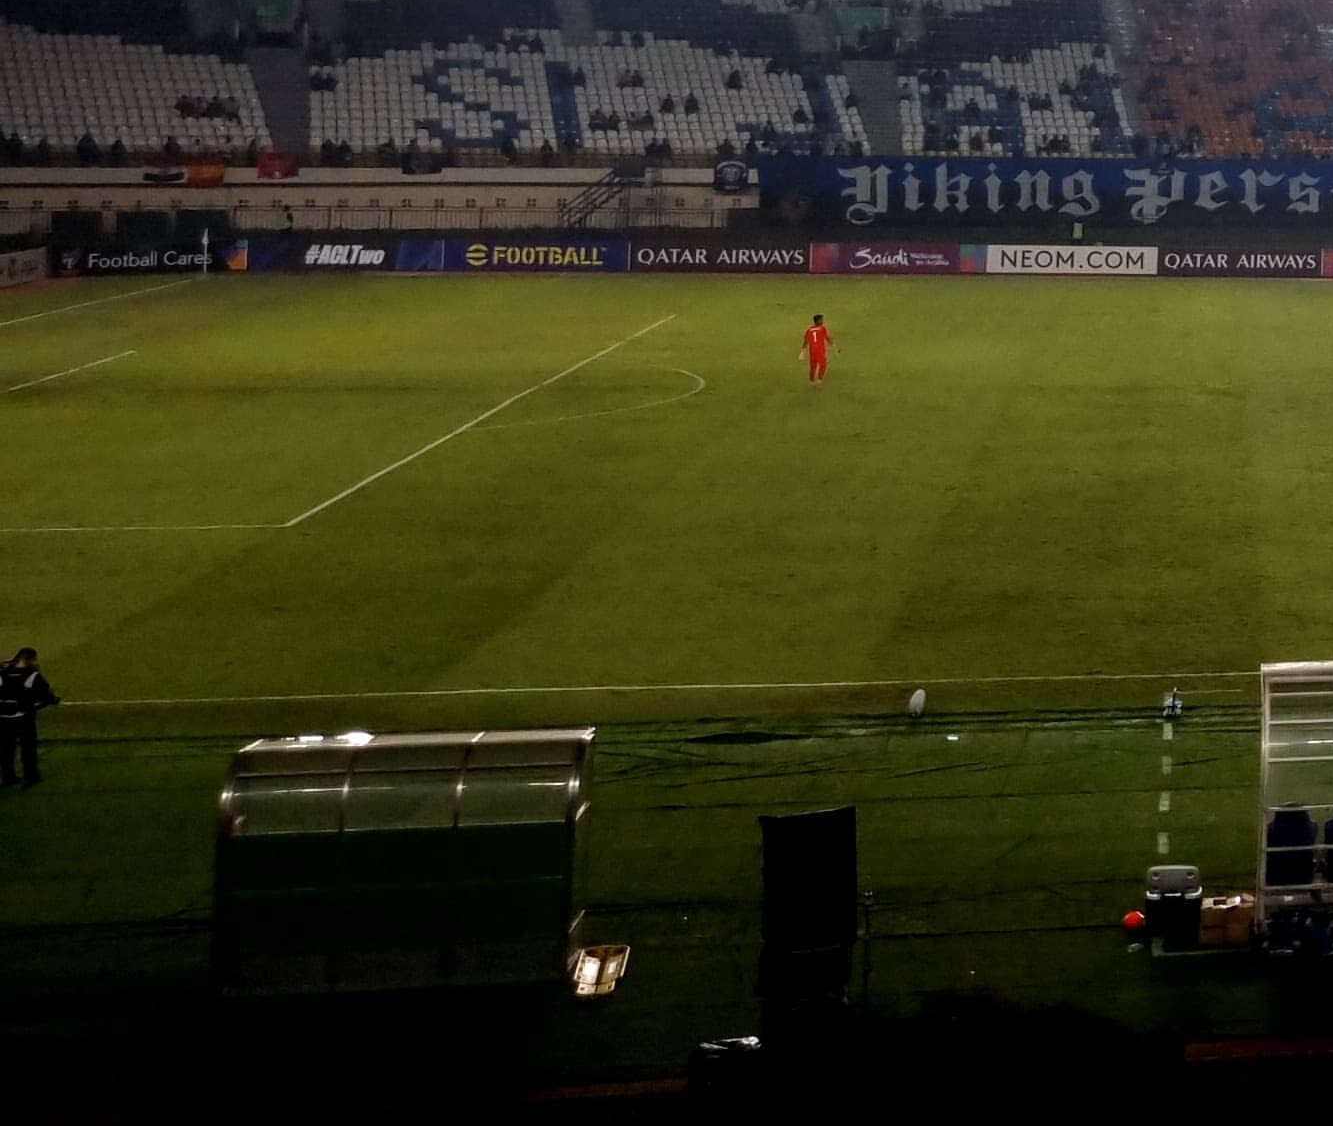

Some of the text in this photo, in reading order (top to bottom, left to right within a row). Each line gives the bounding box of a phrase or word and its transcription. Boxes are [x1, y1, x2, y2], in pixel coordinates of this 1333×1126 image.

[88, 252, 158, 269] Football
[304, 244, 387, 266] #ACLTwo
[637, 249, 805, 265] QATAR AIRWAYS
[1001, 250, 1144, 269] NEOM.COM
[1165, 253, 1317, 271] QATAR AIRWAYS
[813, 330, 818, 344] 1
